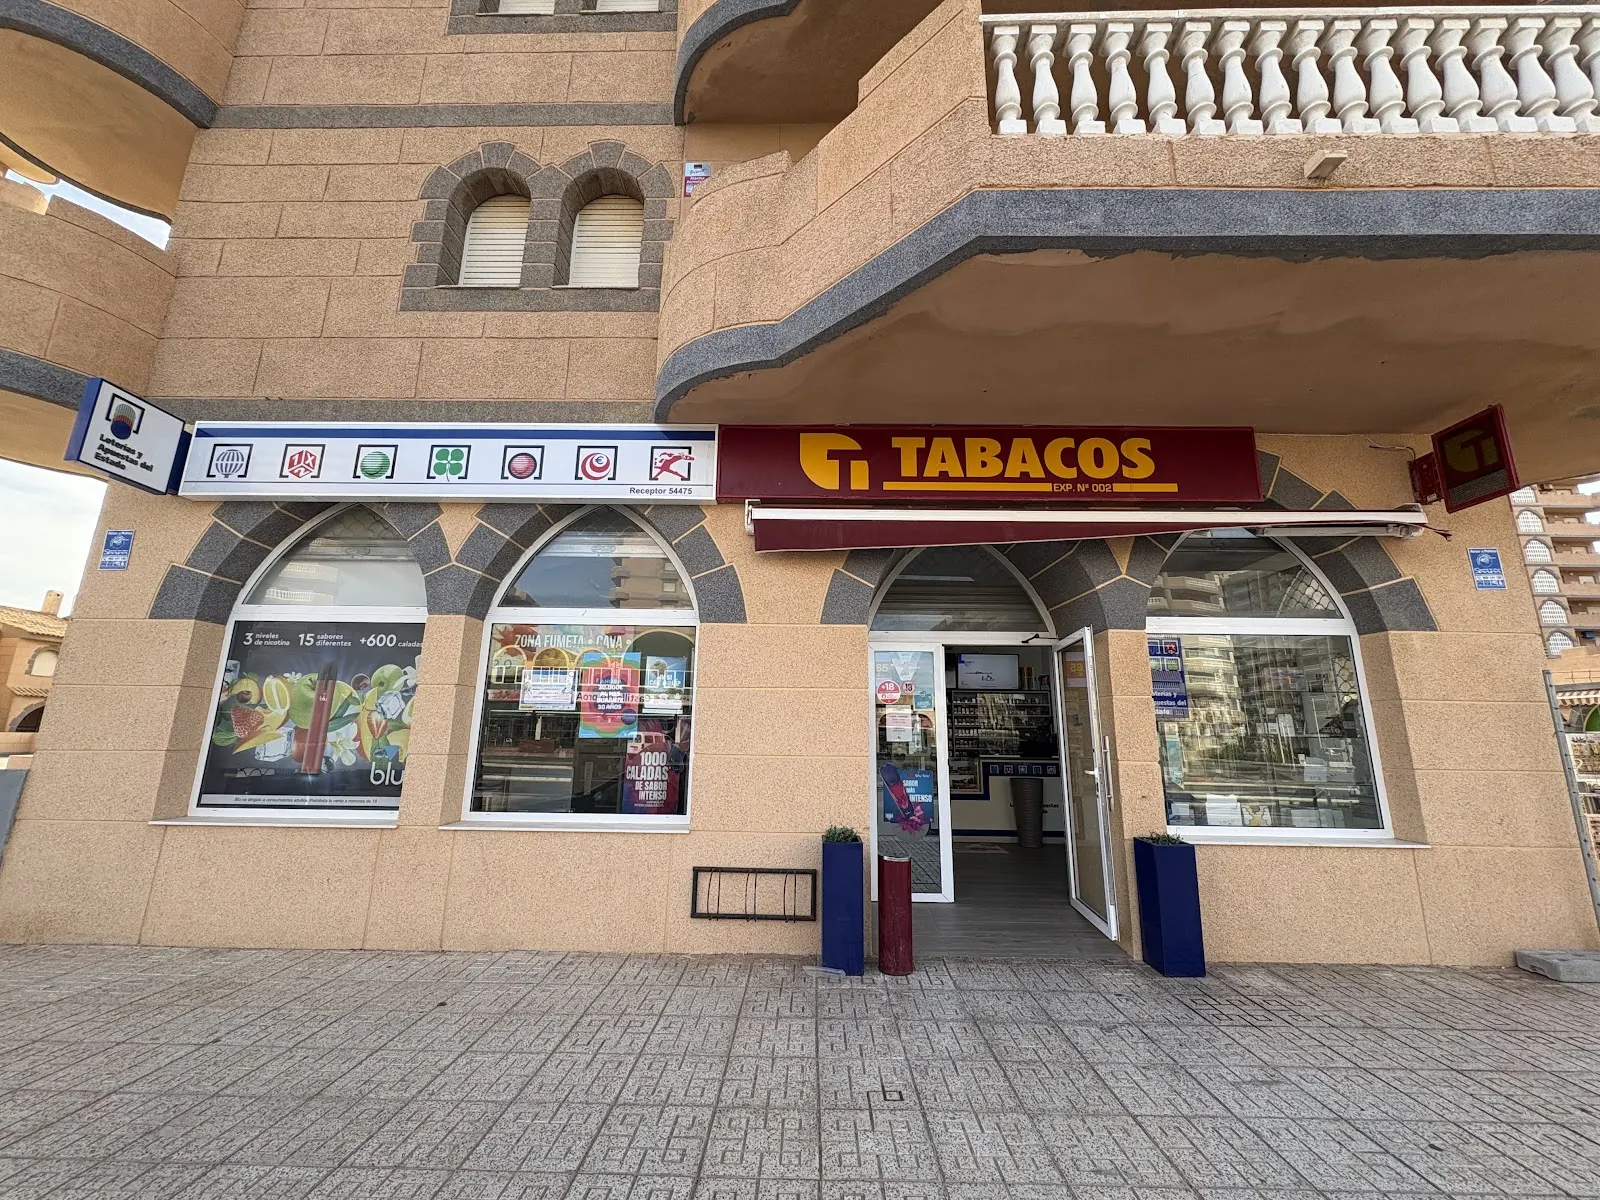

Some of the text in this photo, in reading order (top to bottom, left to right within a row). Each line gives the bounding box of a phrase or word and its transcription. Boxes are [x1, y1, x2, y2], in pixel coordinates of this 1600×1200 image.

[100, 433, 144, 459] Loterías y
[94, 452, 126, 470] Estado
[97, 443, 153, 472] Apuestas del
[891, 436, 1156, 480] TABACOS
[629, 487, 693, 496] Receptor 54475
[1053, 483, 1075, 493] EXP.
[1091, 483, 1112, 493] 002
[242, 632, 254, 646] 3
[298, 633, 315, 646] 15
[315, 639, 352, 647] diferentes
[359, 634, 397, 647] +600
[514, 634, 623, 649] ZONA FUMETA CAVA
[881, 682, 895, 691] +18
[640, 752, 667, 766] 1000
[369, 761, 405, 786] blu
[635, 781, 667, 790] DE SABOR
[639, 790, 667, 800] INTENSO
[909, 794, 932, 802] INTENSO
